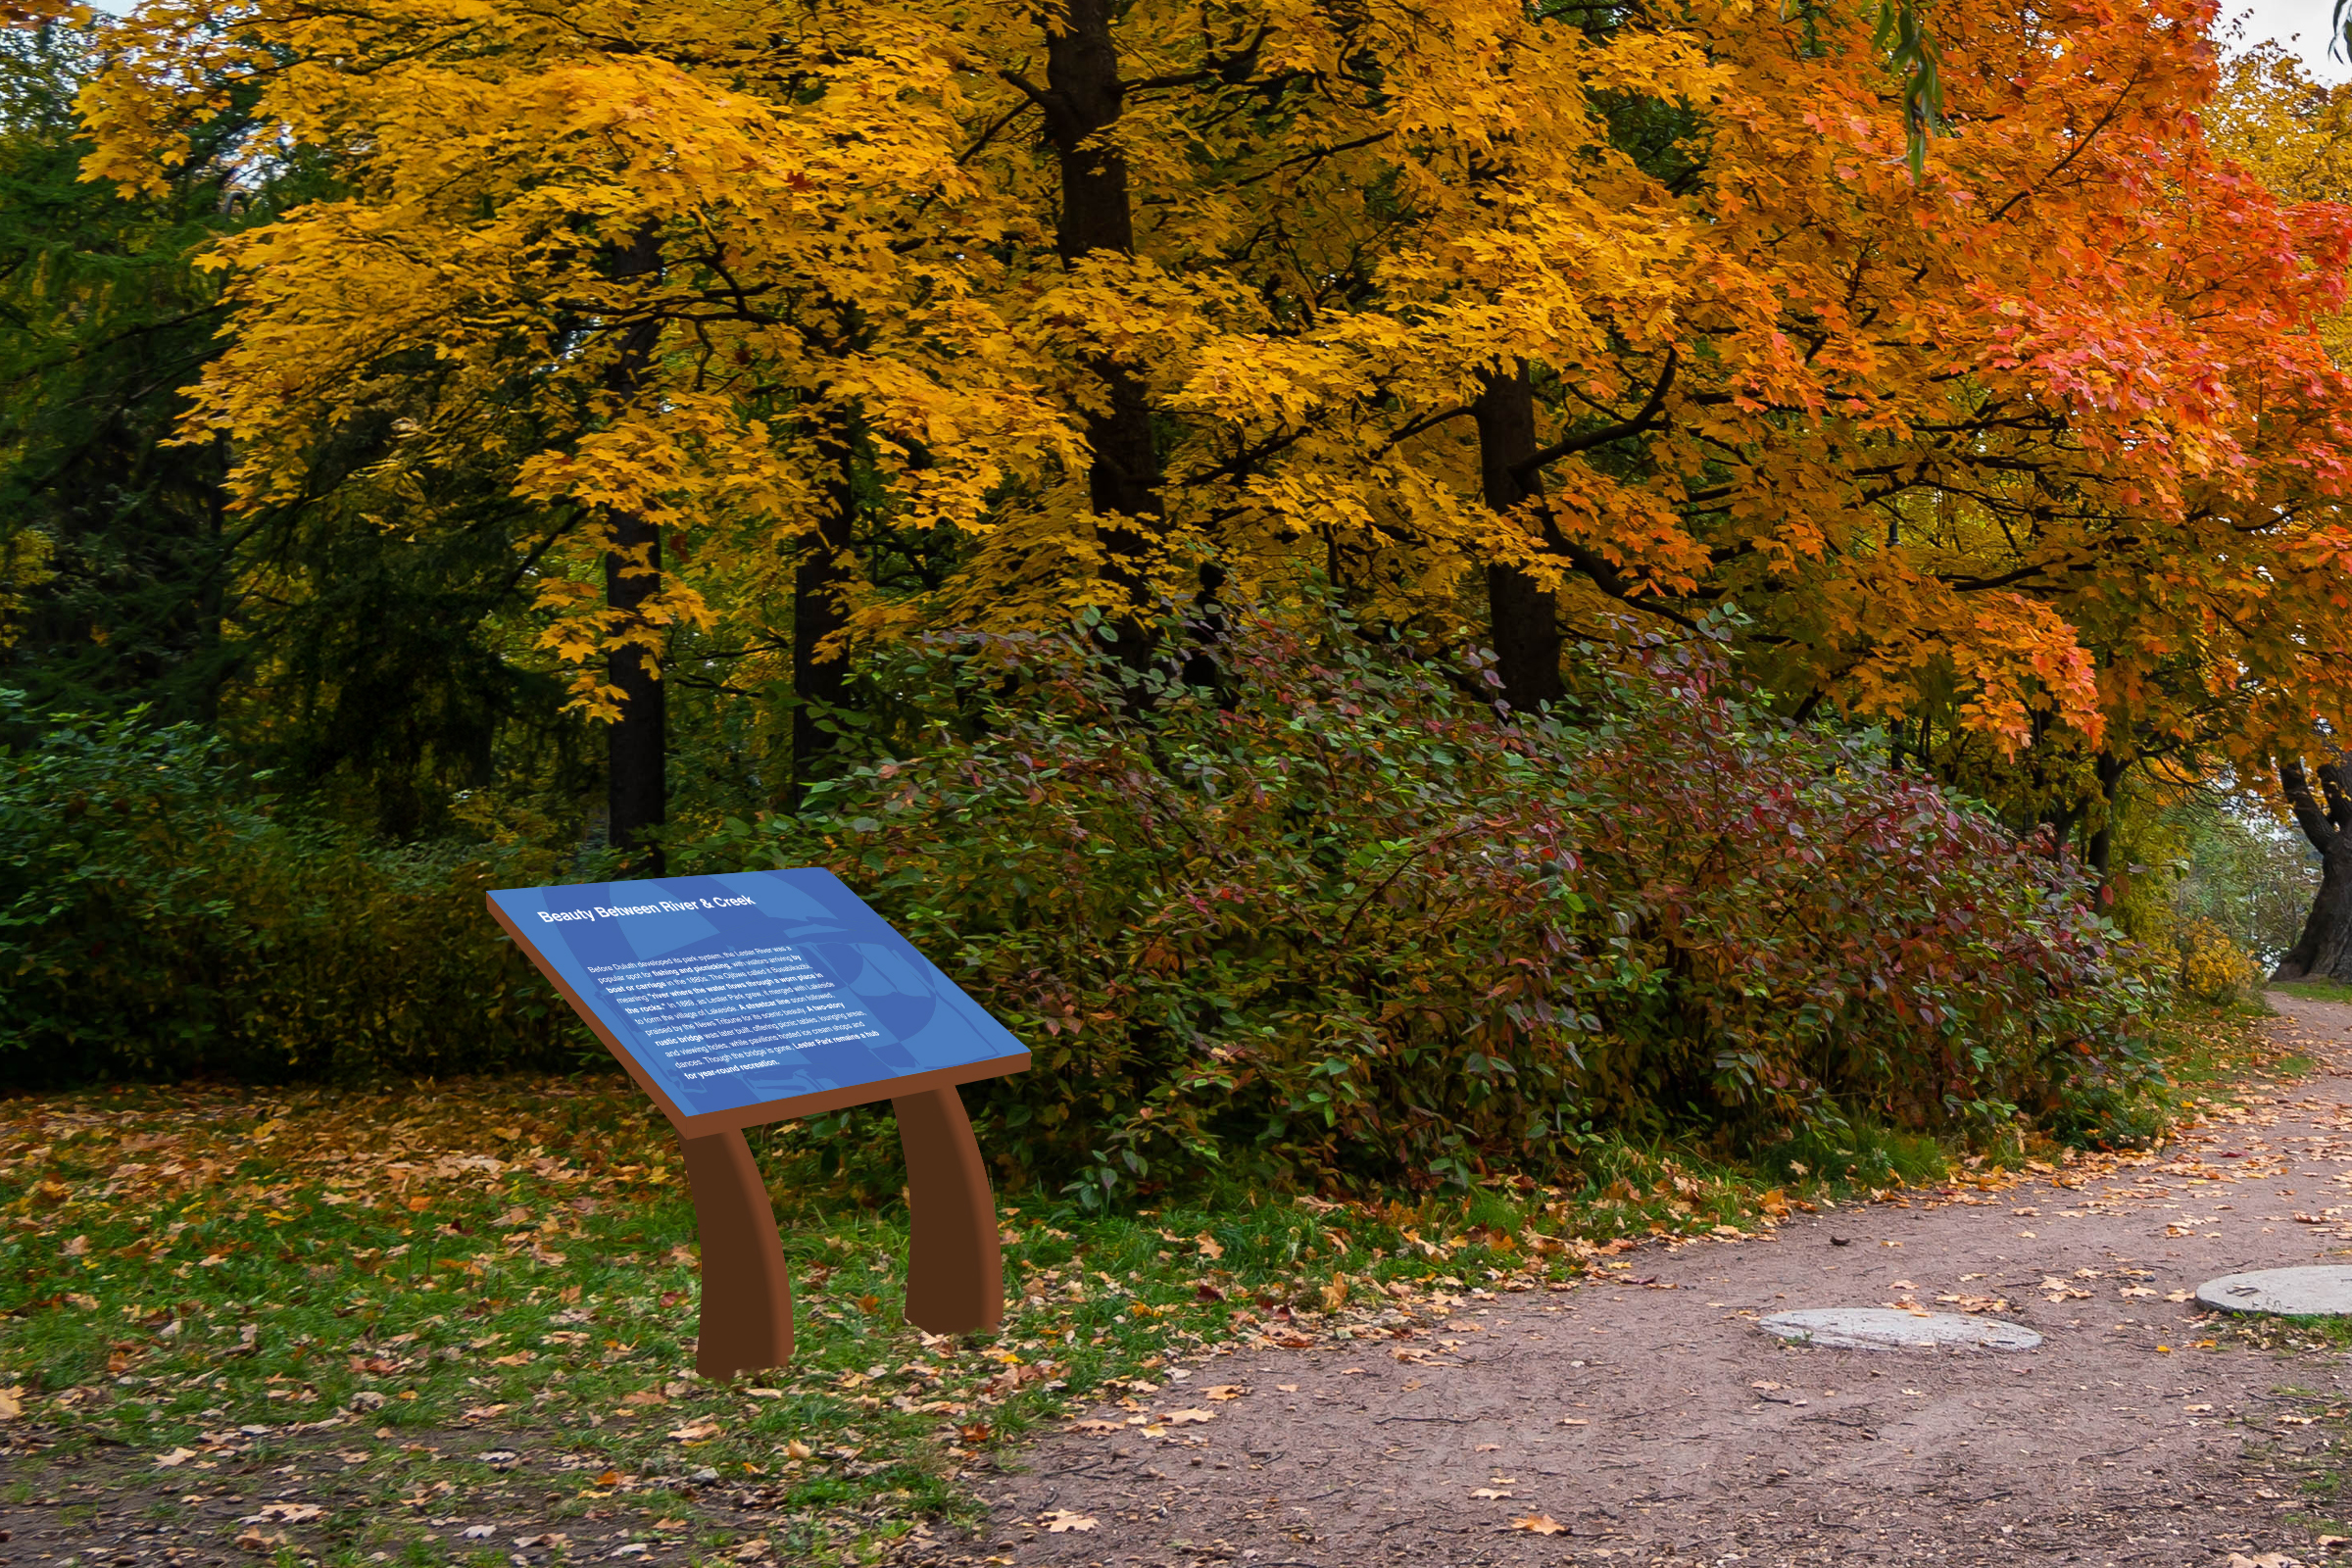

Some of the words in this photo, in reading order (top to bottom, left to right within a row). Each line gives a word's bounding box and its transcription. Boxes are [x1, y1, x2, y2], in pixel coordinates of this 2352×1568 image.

[536, 908, 596, 923] Beauty
[593, 905, 662, 918] Between
[659, 901, 699, 912] River
[699, 898, 715, 908] &
[712, 895, 757, 907] Creek
[637, 957, 673, 968] developed
[598, 975, 625, 985] popular
[625, 972, 643, 981] spot
[651, 968, 680, 977] fishing
[635, 981, 667, 990] carriage
[616, 995, 650, 1004] meaning
[745, 978, 775, 987] through
[745, 1001, 776, 1009] streetcar
[645, 1026, 673, 1037] praised
[760, 1010, 784, 1019] scenic
[811, 1002, 846, 1011] two-story
[655, 1037, 679, 1047] rustic
[676, 1034, 705, 1043] bridge
[734, 1026, 754, 1035] built,
[752, 1023, 780, 1032] offering
[777, 1020, 798, 1029] picnic
[664, 1049, 680, 1057] and
[679, 1046, 710, 1055] viewing
[776, 1031, 802, 1040] hosted
[811, 1026, 834, 1035] cream
[702, 1054, 733, 1063] Though
[742, 1049, 767, 1057] bridge
[773, 1045, 795, 1054] gone,
[792, 1041, 816, 1050] Lester
[814, 1037, 834, 1046] Park
[832, 1034, 861, 1043] remains
[697, 1064, 740, 1079] year-round
[739, 1059, 780, 1071] recreation.
